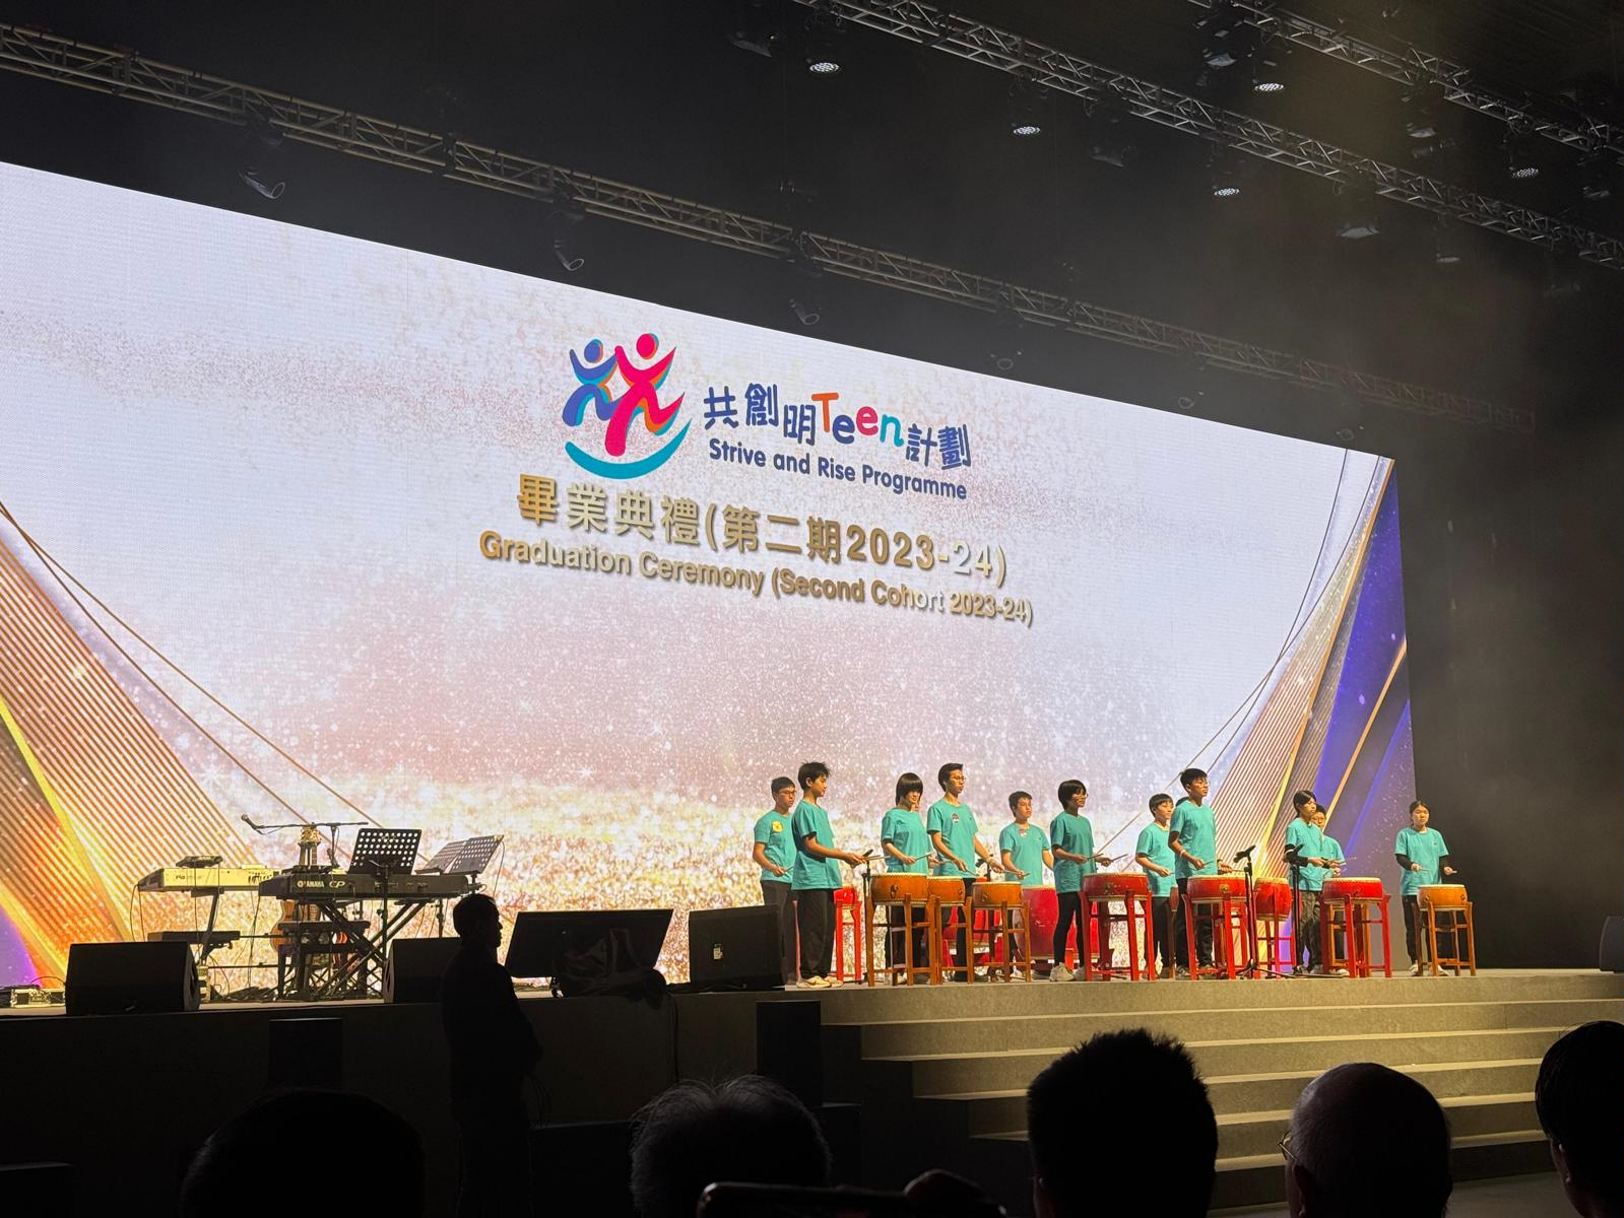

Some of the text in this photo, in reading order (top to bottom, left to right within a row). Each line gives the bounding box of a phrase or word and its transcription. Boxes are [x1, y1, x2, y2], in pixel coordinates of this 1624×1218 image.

[703, 383, 972, 470] 共創明Teen計劃
[709, 437, 967, 500] Strive and Rise Programme
[479, 530, 1034, 629] Graduation Ceremony (Second Cohort 2023-24)
